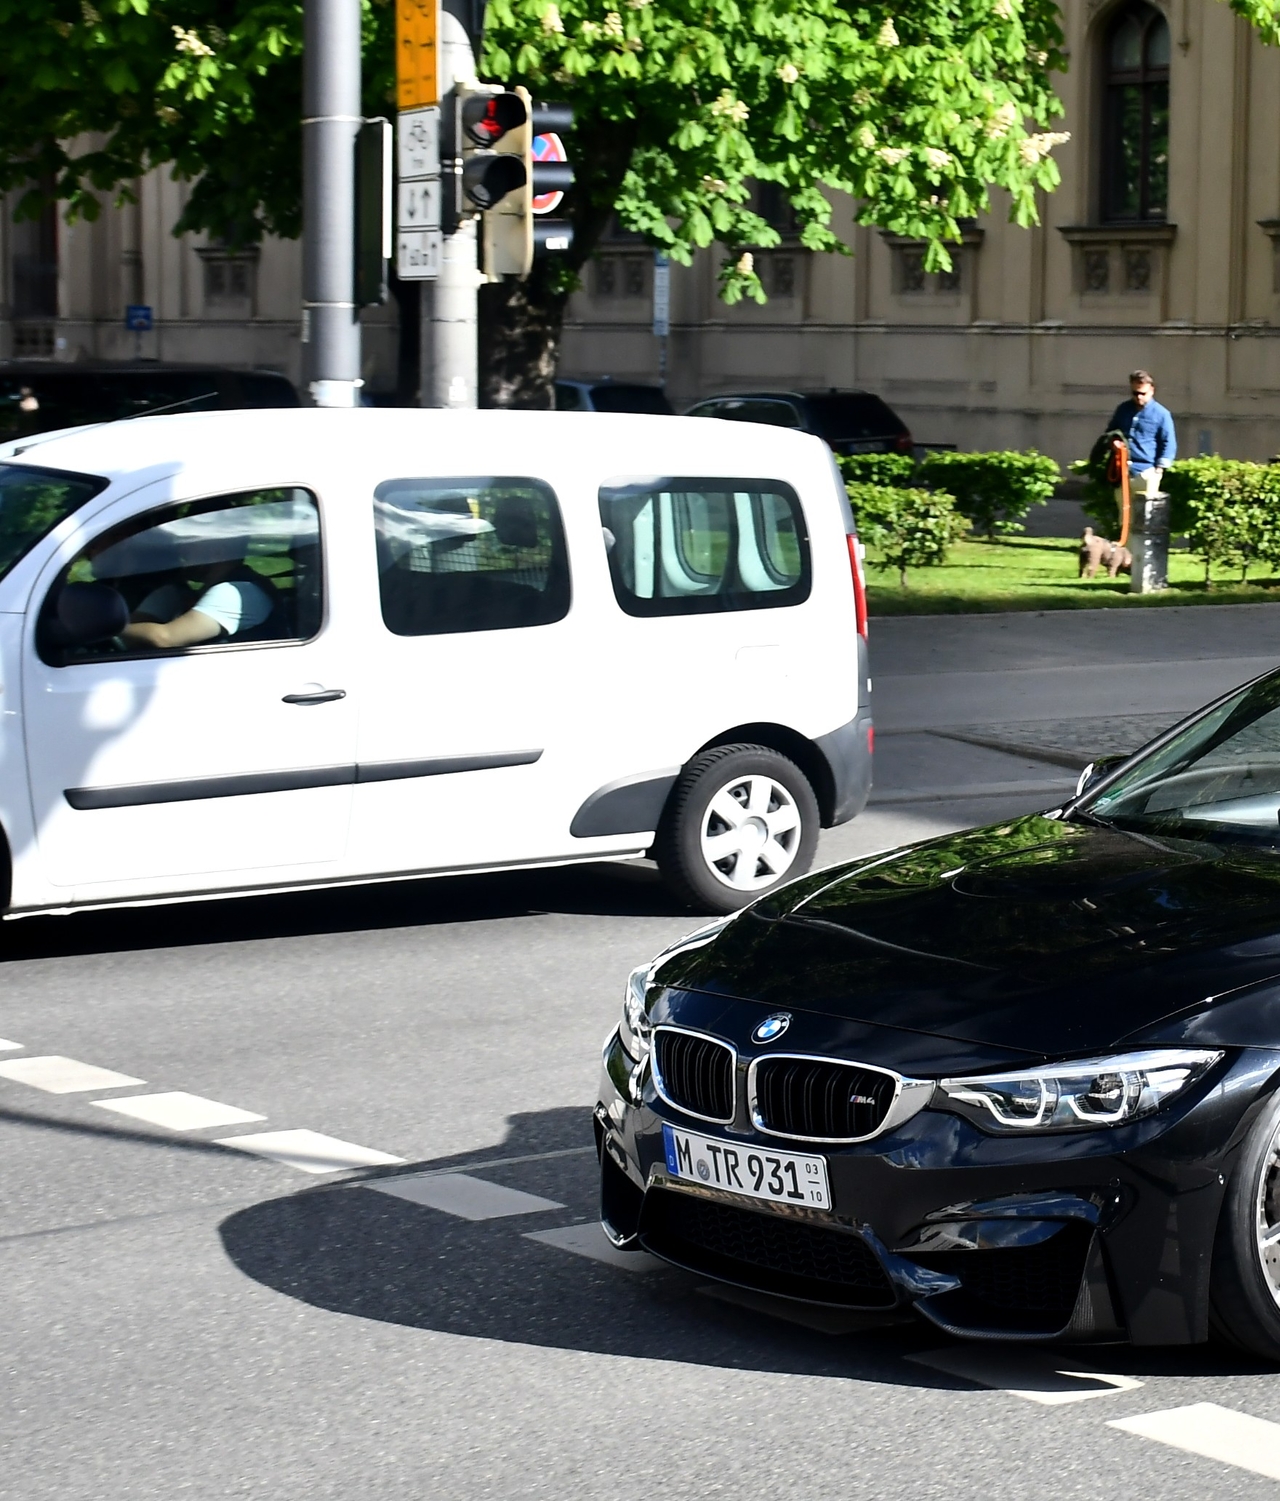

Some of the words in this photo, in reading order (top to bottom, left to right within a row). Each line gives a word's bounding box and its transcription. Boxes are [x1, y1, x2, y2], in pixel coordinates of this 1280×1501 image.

[675, 1135, 694, 1175] M
[706, 1144, 744, 1188] TR
[747, 1154, 805, 1200] 931
[805, 1163, 819, 1175] 03
[810, 1190, 823, 1202] 10
